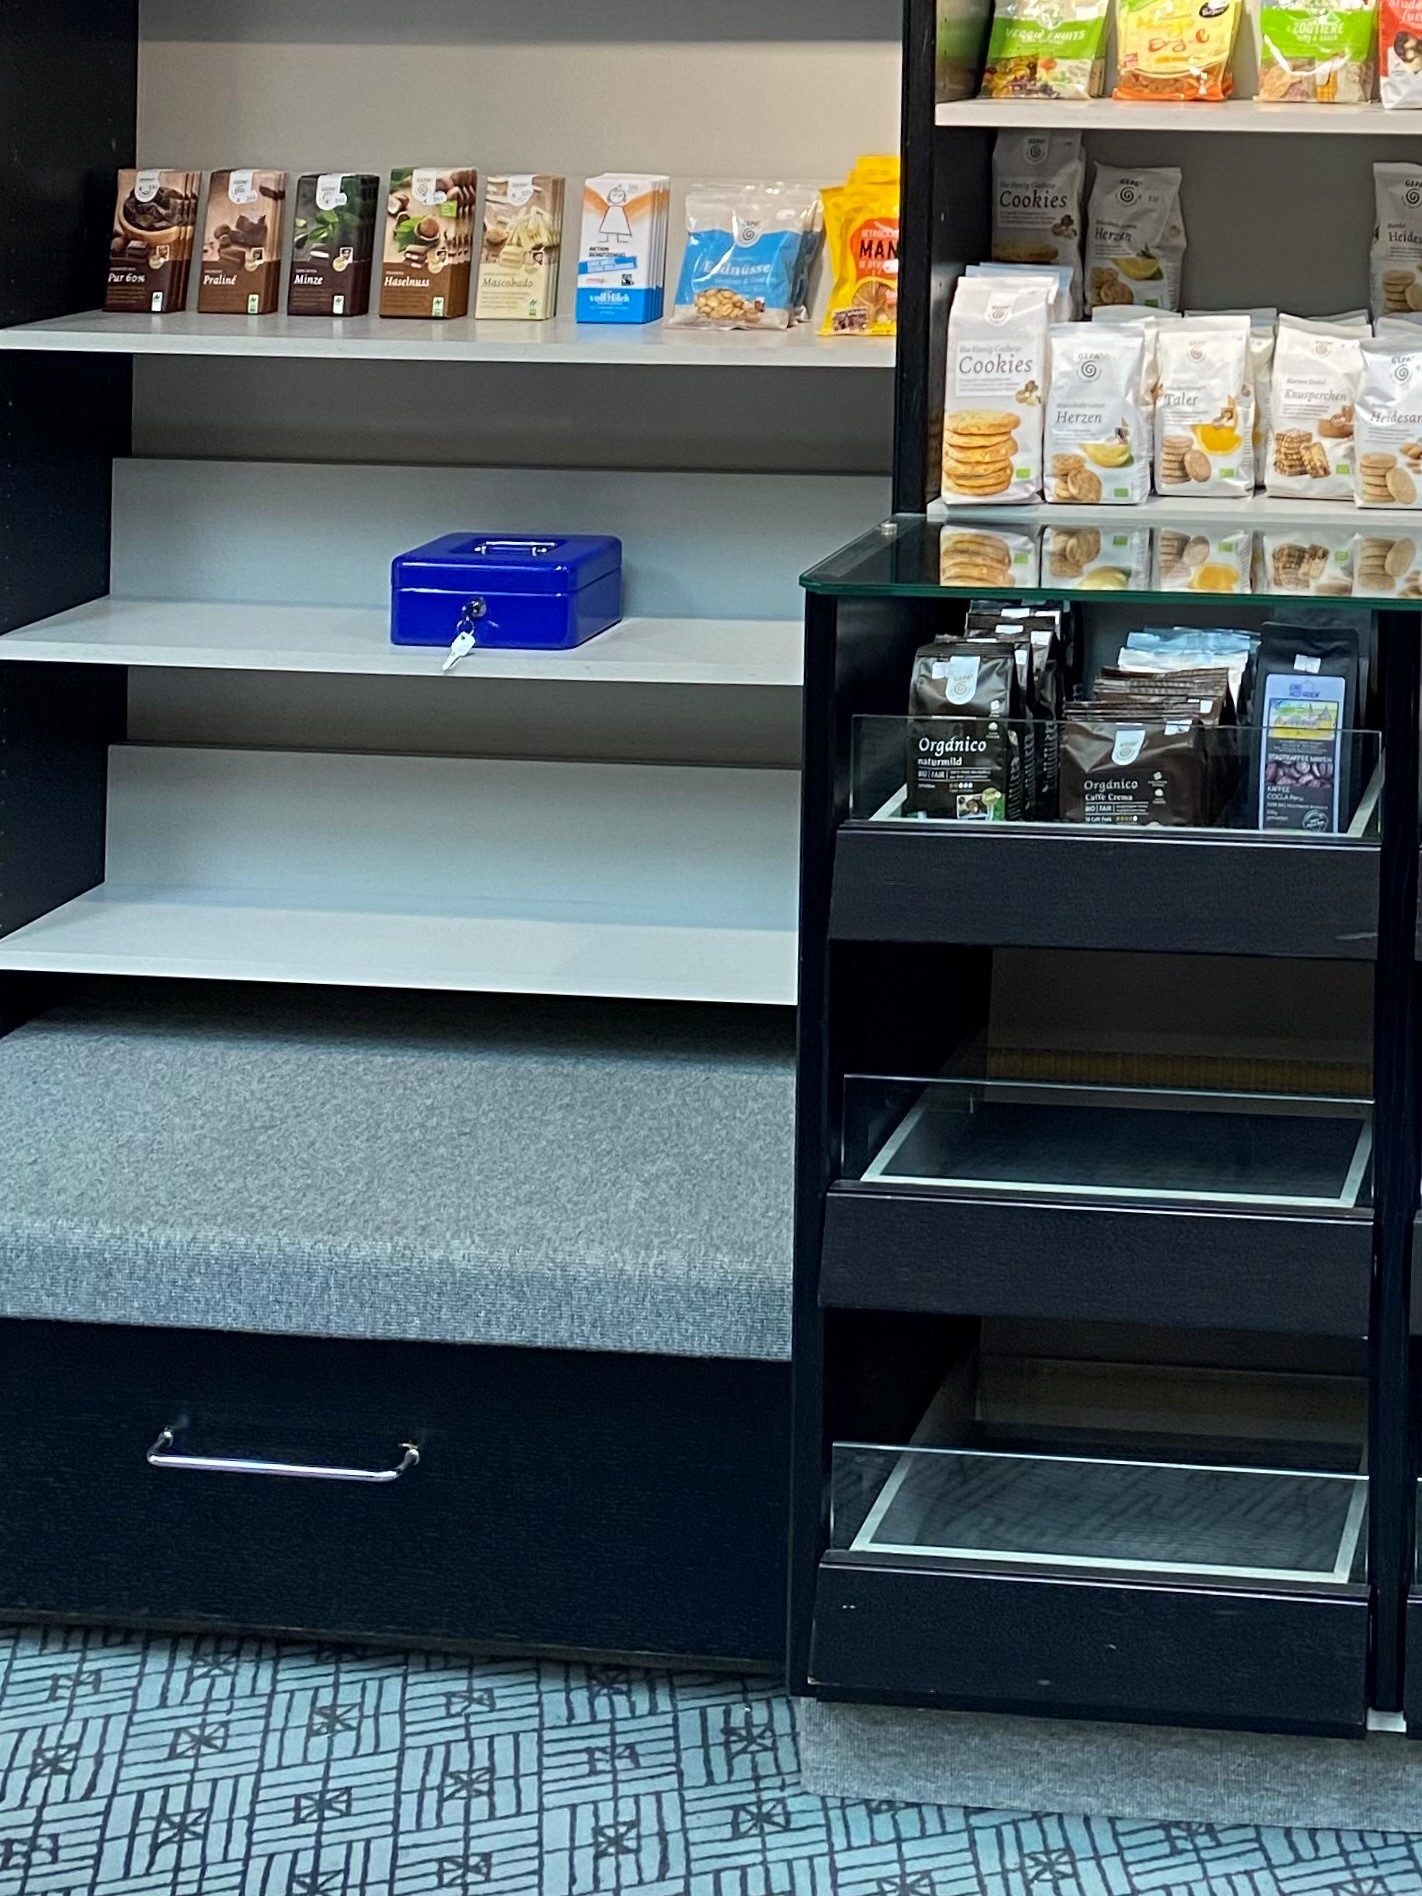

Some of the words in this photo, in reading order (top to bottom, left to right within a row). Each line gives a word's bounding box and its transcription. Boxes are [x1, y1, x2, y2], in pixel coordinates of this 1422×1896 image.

[1000, 188, 1068, 208] Cookies
[1094, 226, 1133, 242] Herzen
[203, 274, 238, 285] Praliné
[294, 274, 324, 285] Minze
[384, 276, 431, 287] Haselnuss
[482, 277, 534, 288] Mascobado
[958, 354, 1034, 374] Cookies
[1164, 392, 1199, 406] Taler
[1284, 388, 1348, 402] Knusperchen
[1055, 411, 1103, 425] Herzen
[918, 735, 987, 757] Orgánico
[917, 756, 963, 766] naturmild
[930, 770, 946, 779] FAIR
[1083, 778, 1139, 792] Orgánico
